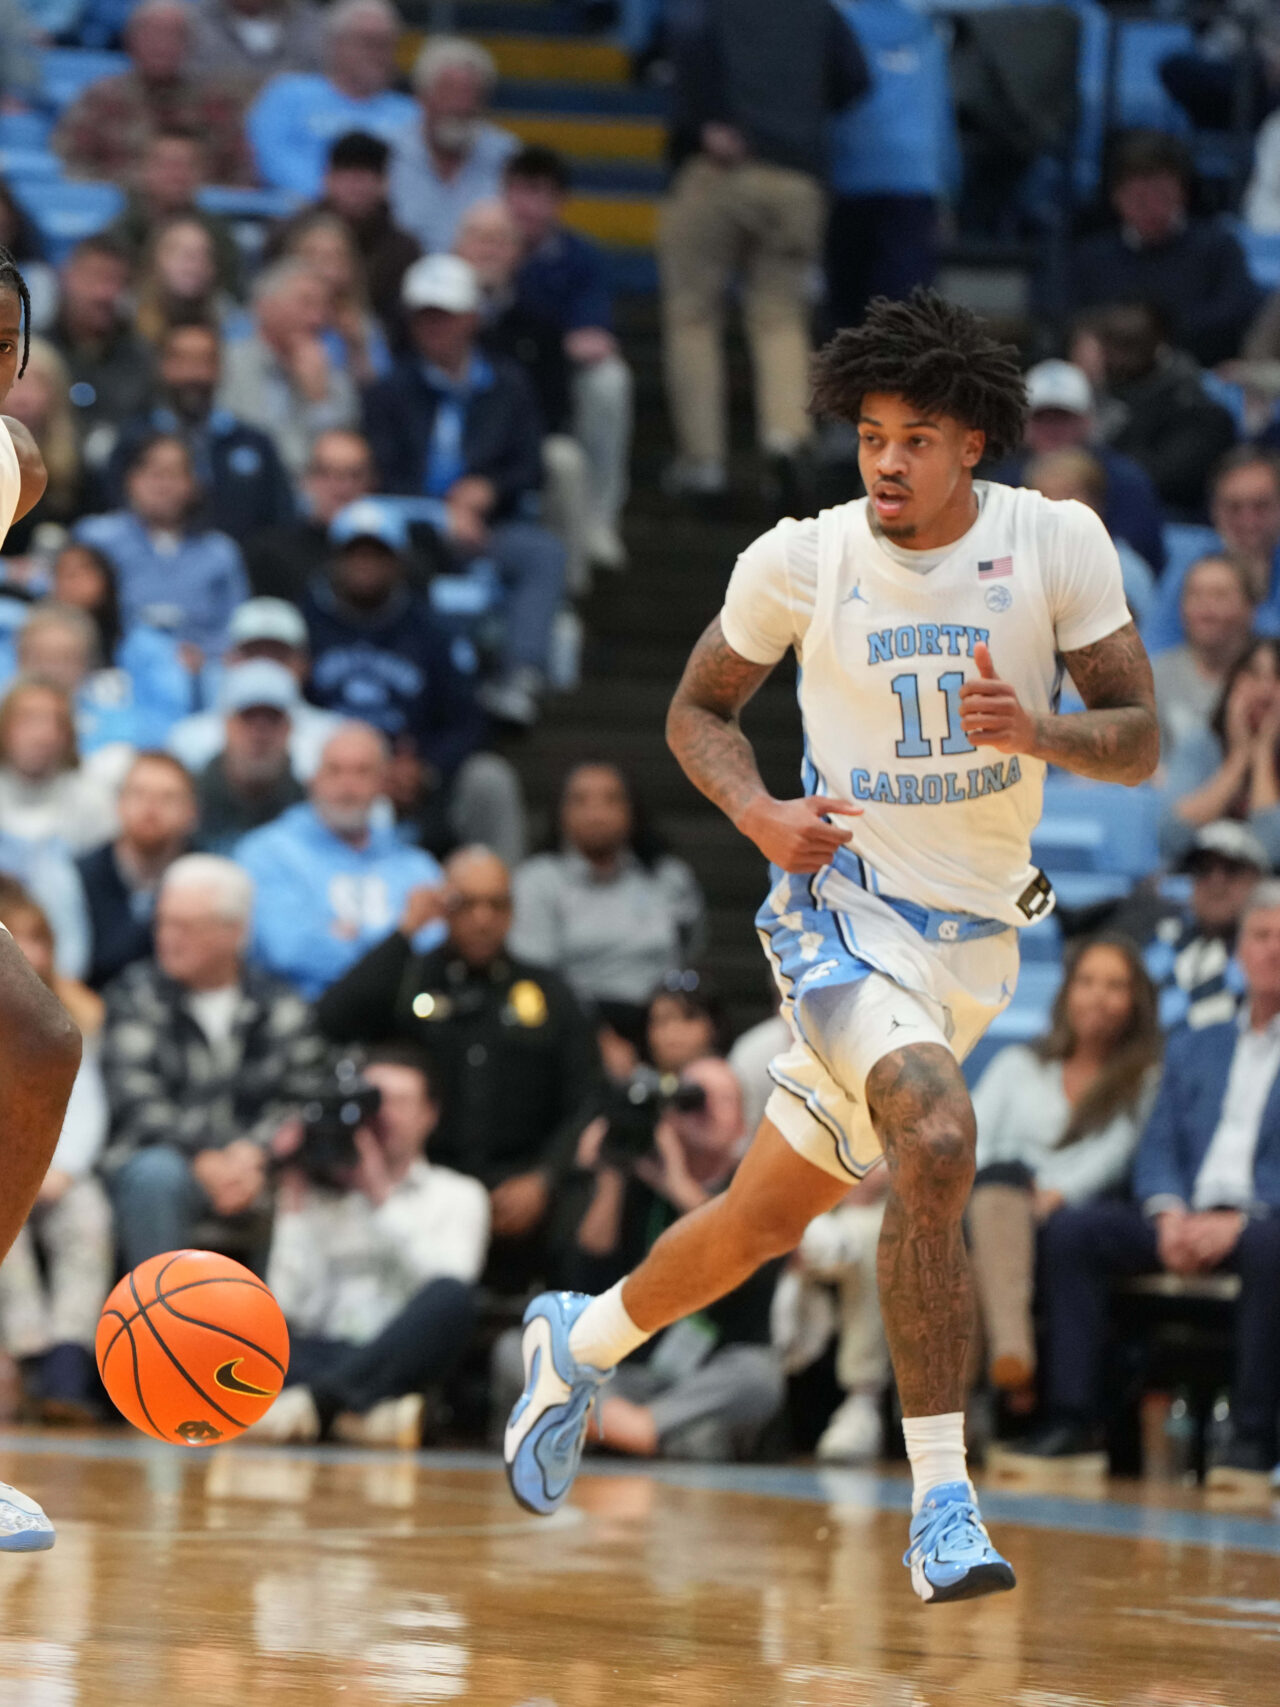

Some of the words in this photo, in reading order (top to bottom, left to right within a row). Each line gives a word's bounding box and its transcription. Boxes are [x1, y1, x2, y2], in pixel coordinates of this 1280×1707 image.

[867, 623, 990, 666] NORTH
[890, 671, 977, 759] 11
[850, 754, 1022, 805] CAROLINA
